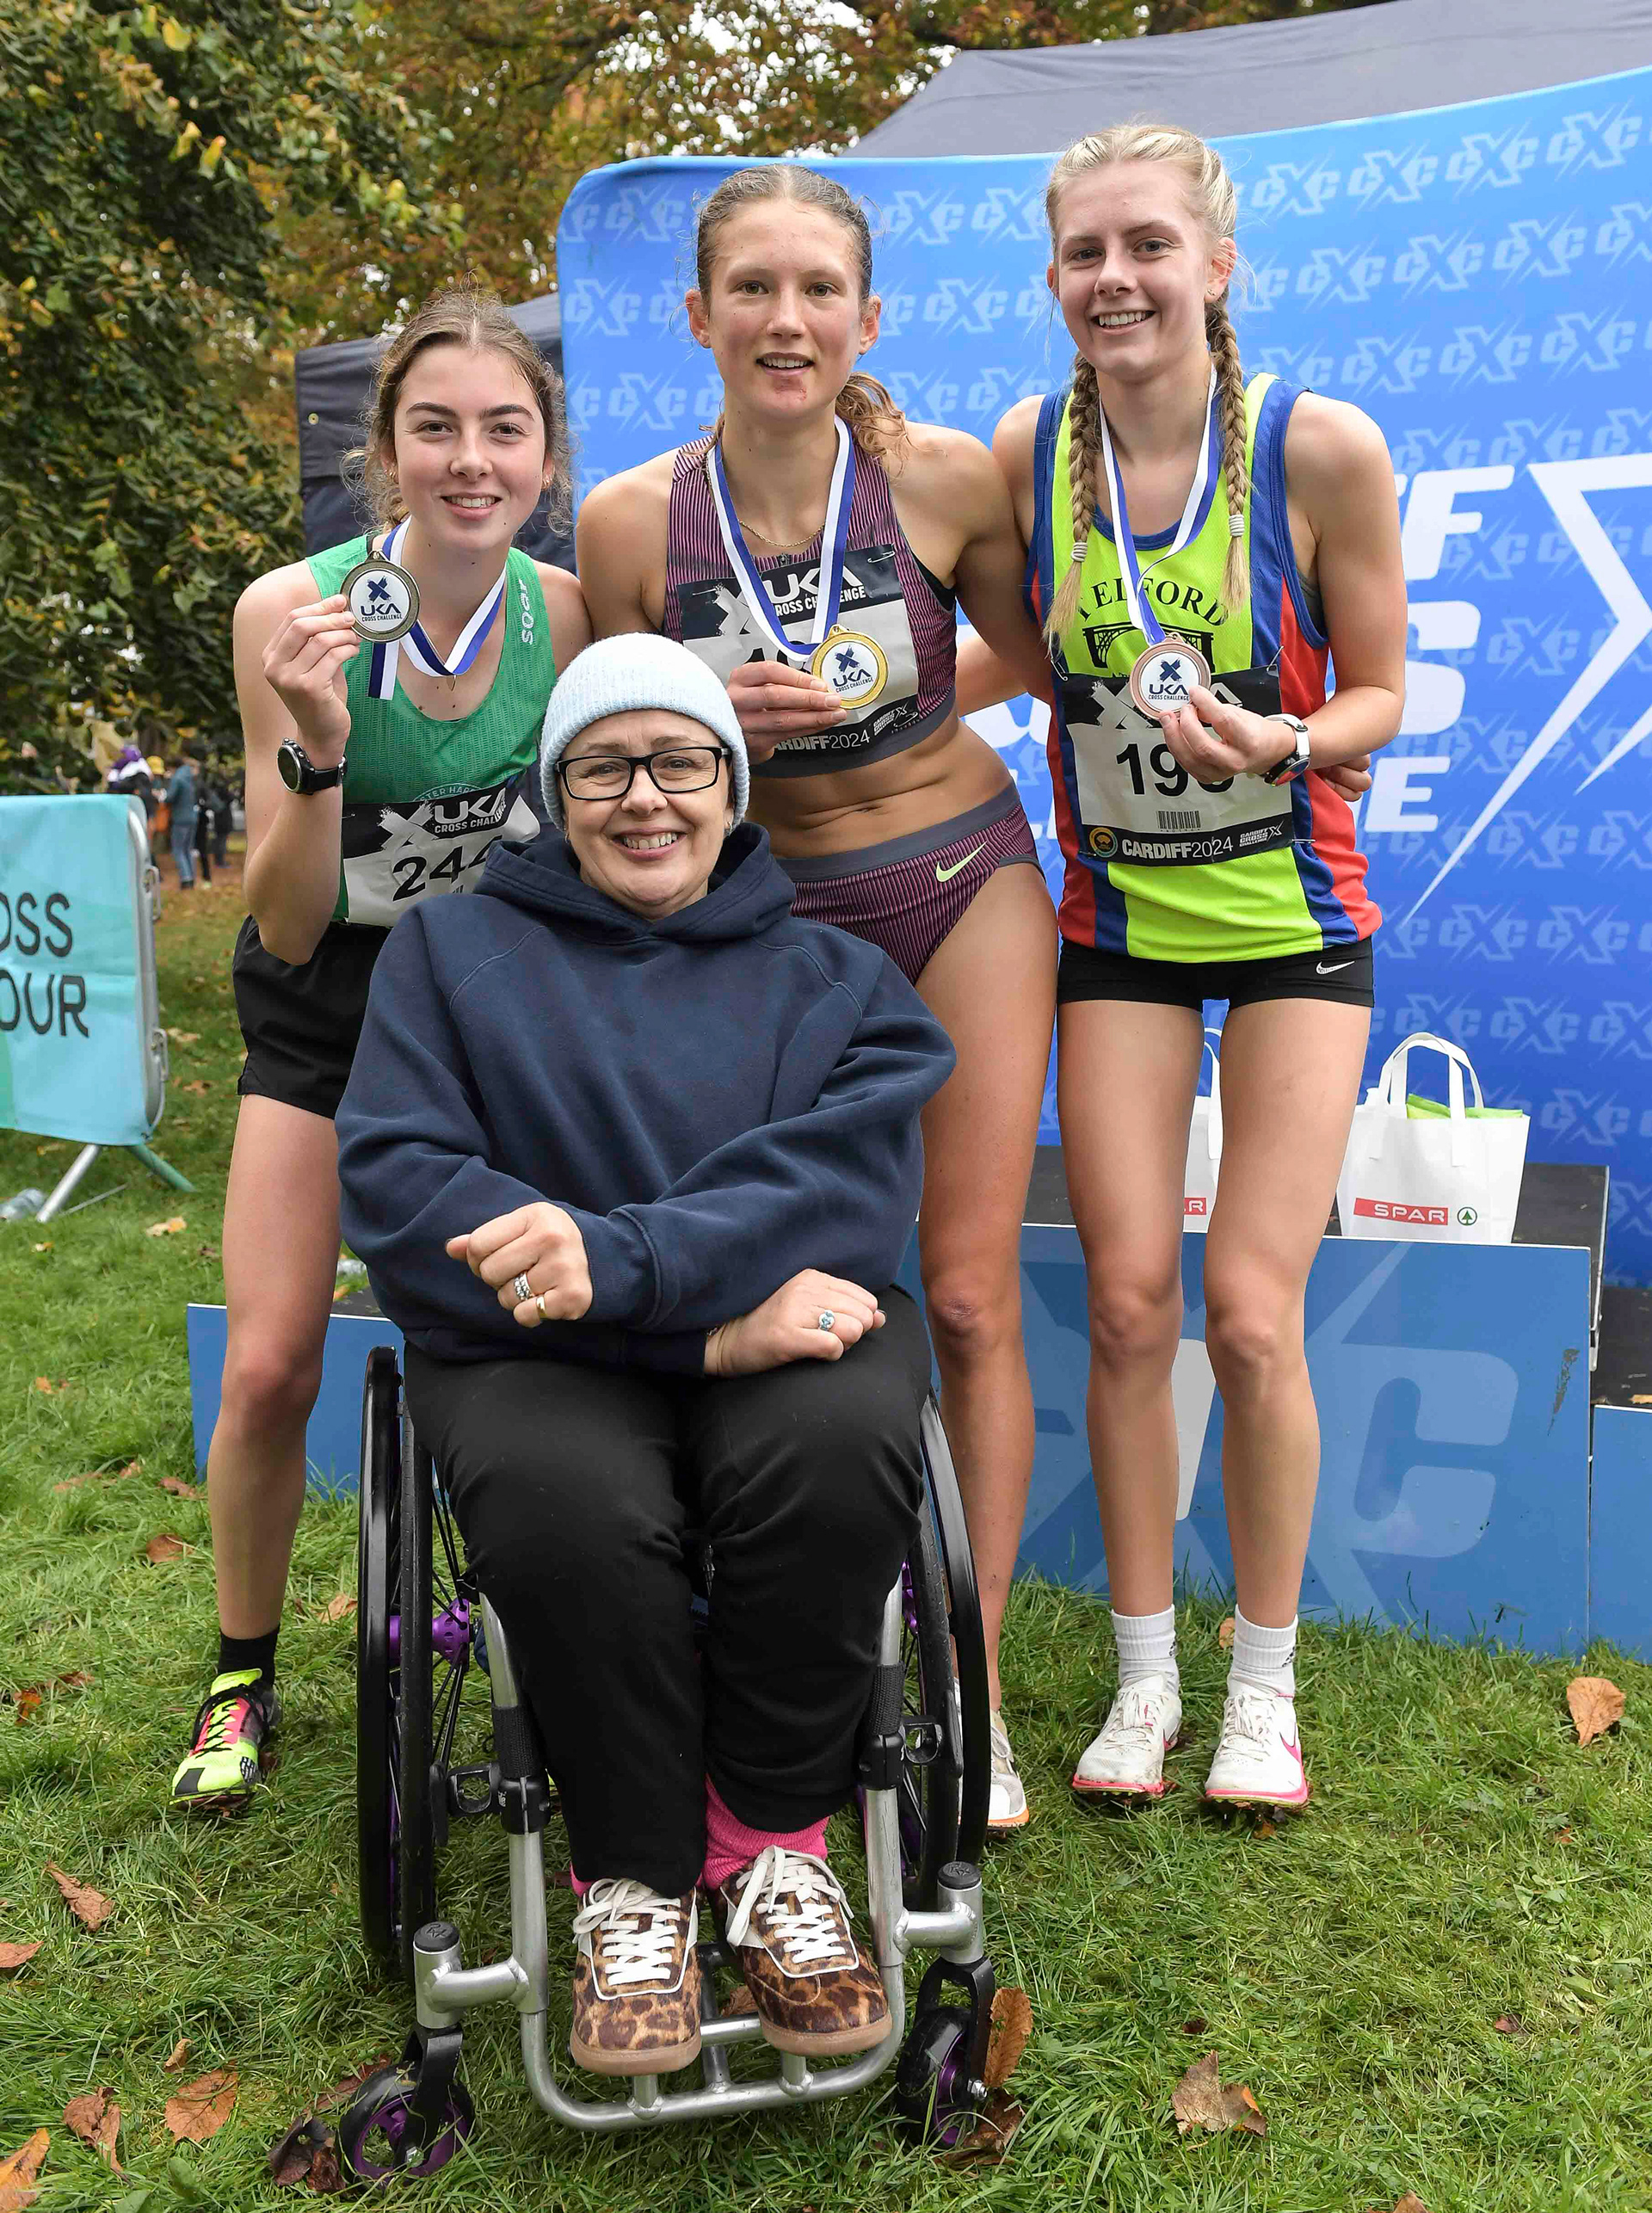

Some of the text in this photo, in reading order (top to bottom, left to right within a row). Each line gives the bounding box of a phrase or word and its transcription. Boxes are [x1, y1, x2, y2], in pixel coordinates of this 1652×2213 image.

[361, 603, 401, 616] UKA
[774, 586, 866, 617] ROSS CHNGE
[833, 669, 872, 687] UKA
[835, 677, 873, 693] CROSS CHALLENGE
[1150, 684, 1188, 695] UKA
[774, 729, 871, 750] RDIFF2024
[435, 787, 506, 824] UKA
[435, 822, 468, 834] CROSS
[1374, 1204, 1446, 1223] SPAR
